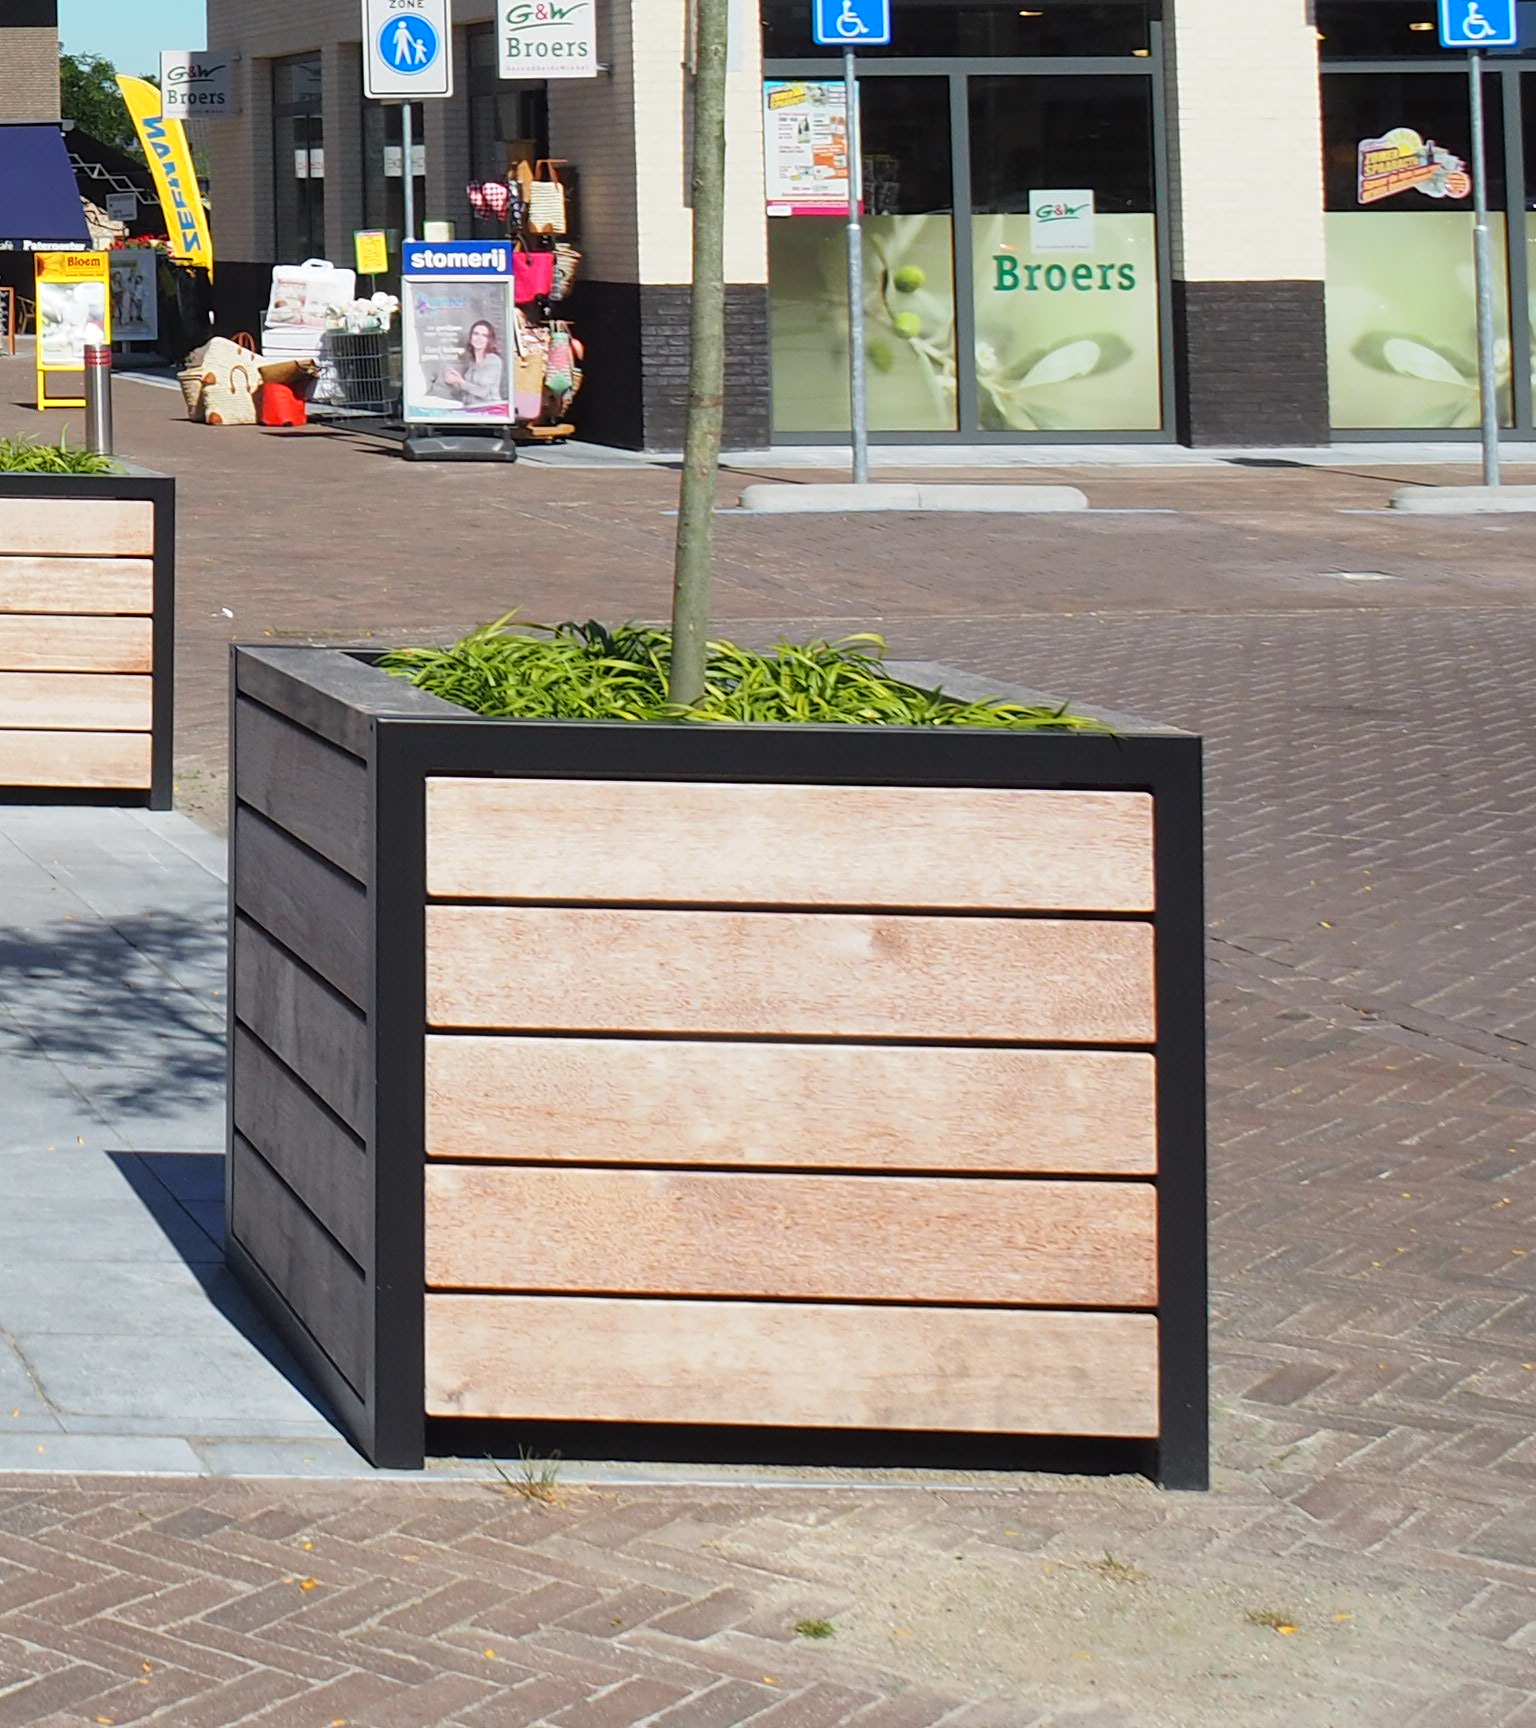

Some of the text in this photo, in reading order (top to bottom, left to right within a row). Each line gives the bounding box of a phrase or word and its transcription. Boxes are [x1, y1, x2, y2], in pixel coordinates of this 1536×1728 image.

[389, 0, 425, 9] ZONE
[506, 2, 589, 24] G&W
[506, 37, 589, 58] Broers
[167, 64, 226, 81] G&W
[167, 89, 226, 105] Broers
[1035, 203, 1091, 219] G&W
[67, 256, 101, 267] Bloem
[411, 248, 507, 272] stomerij
[992, 255, 1136, 291] Broers
